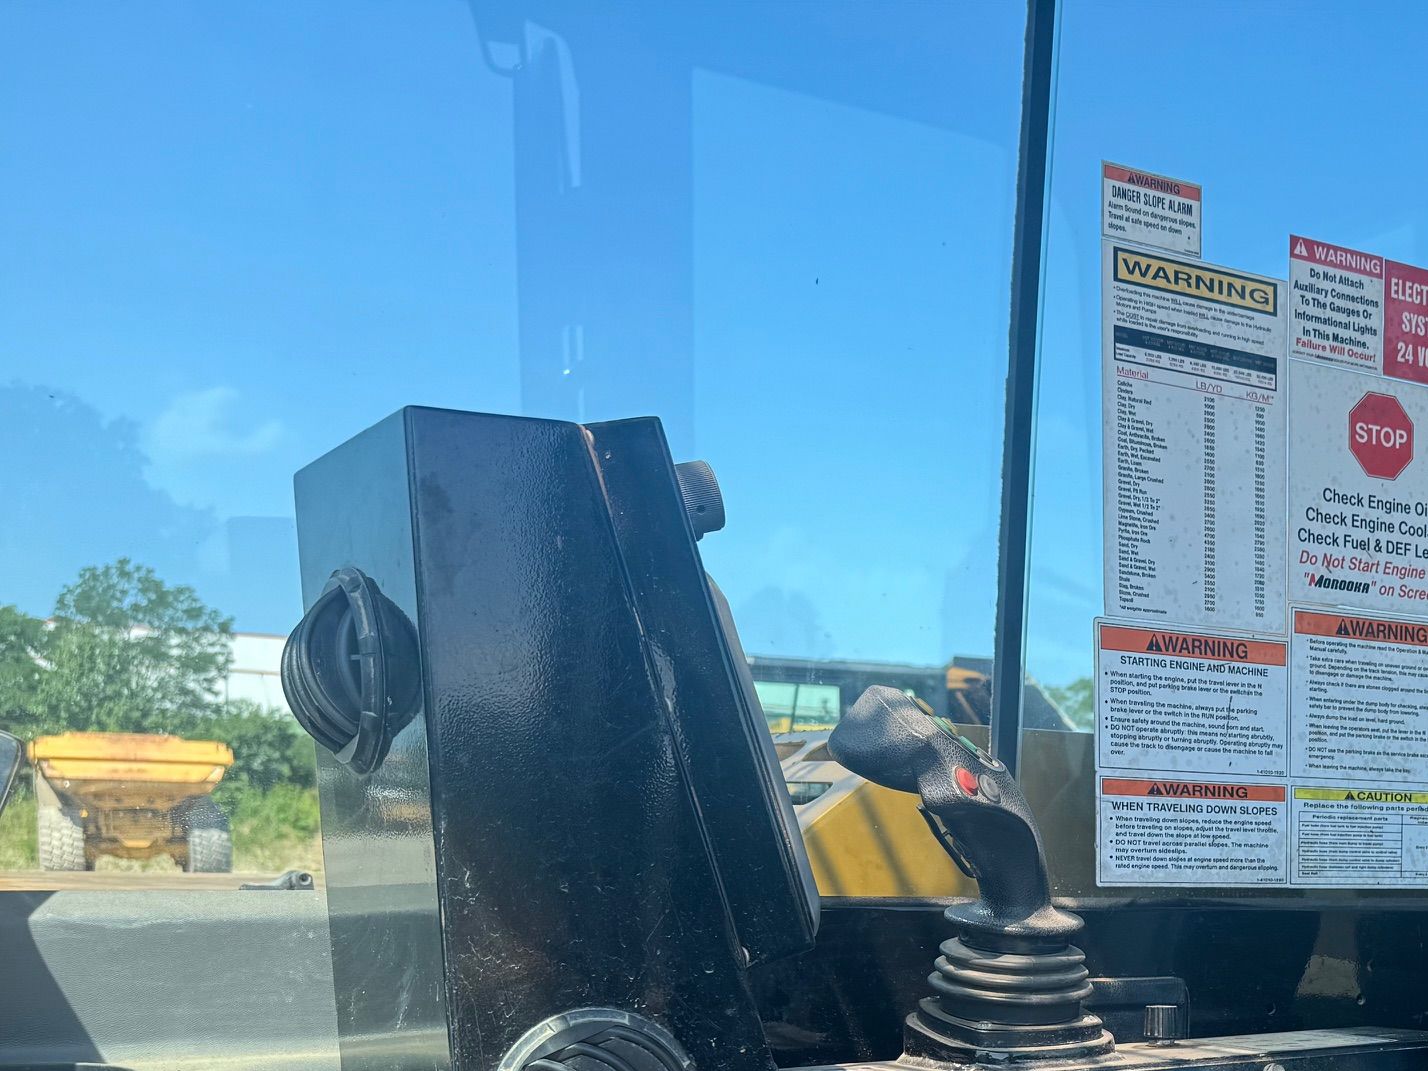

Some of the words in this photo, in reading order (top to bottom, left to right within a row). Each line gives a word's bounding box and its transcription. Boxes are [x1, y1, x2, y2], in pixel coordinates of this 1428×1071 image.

[1135, 175, 1180, 194] WARNING
[1108, 200, 1124, 211] Alarm
[1150, 211, 1178, 224] dangerous
[1112, 185, 1141, 203] DANGER
[1143, 193, 1165, 210] SLOPE
[1168, 200, 1193, 216] ALARM
[1314, 246, 1380, 273] WARNING
[1123, 259, 1269, 304] WARNING
[1309, 268, 1321, 280] Do
[1323, 271, 1337, 283] Not
[1338, 275, 1364, 290] Attach
[1293, 280, 1329, 298] Auxiliary
[1330, 288, 1379, 308] Connections
[1300, 294, 1310, 306] To
[1311, 297, 1327, 310] The
[1329, 302, 1360, 318] Gauges
[1362, 309, 1372, 320] Or
[1294, 309, 1351, 330] Informational
[1352, 322, 1377, 336] Lights
[1303, 326, 1311, 337] In
[1312, 328, 1330, 341] This
[1332, 332, 1369, 349] Machine.
[1296, 337, 1327, 352] Failure
[1329, 344, 1345, 356] Will
[1347, 348, 1376, 363] Occur!
[1397, 342, 1413, 364] 24
[1116, 366, 1149, 379] Material
[1195, 381, 1223, 395] LB/YD
[1356, 422, 1407, 448] STOP
[1323, 488, 1364, 507] Check
[1368, 495, 1411, 514] Engine
[1306, 507, 1347, 526] Check
[1351, 514, 1395, 533] Engine
[1298, 528, 1339, 547] Check
[1343, 534, 1370, 551] Fuel
[1374, 538, 1382, 553] &
[1386, 540, 1411, 556] DEF
[1299, 550, 1318, 565] Do
[1322, 553, 1345, 569] Not
[1348, 557, 1380, 574] Start
[1383, 561, 1426, 580] Engine
[1379, 585, 1395, 597] on
[1350, 620, 1427, 643] WARNING
[1162, 635, 1247, 659] WARNING
[1110, 670, 1128, 678] When
[1129, 673, 1152, 681] starting
[1120, 655, 1167, 668] STARTING
[1169, 660, 1205, 672] ENGINE
[1206, 664, 1226, 673] AND
[1228, 665, 1268, 677] MACHINE
[1110, 686, 1127, 694] STOP
[1164, 784, 1248, 798] WARNING
[1357, 791, 1412, 802] CAUTION
[1111, 801, 1143, 811] WHEN
[1147, 802, 1203, 813] TRAVELING
[1206, 805, 1237, 814] DOWN
[1239, 806, 1277, 816] SLOPES
[1134, 816, 1161, 824] traveling
